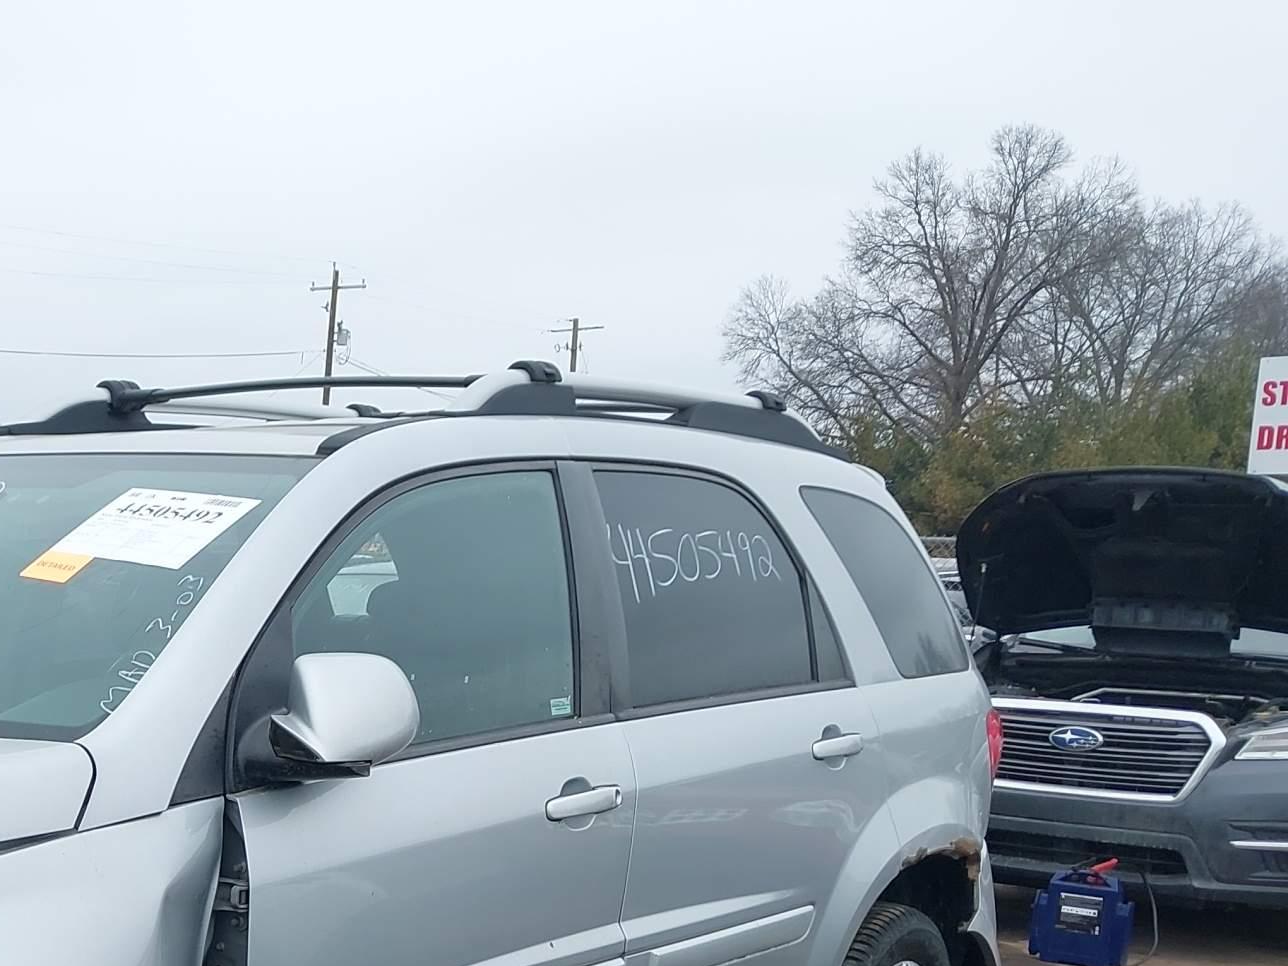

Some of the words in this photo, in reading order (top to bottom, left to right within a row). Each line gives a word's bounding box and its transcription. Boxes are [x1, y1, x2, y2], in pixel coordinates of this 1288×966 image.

[1256, 426, 1288, 451] DR
[116, 502, 223, 524] 44505492
[606, 523, 782, 604] 44505492
